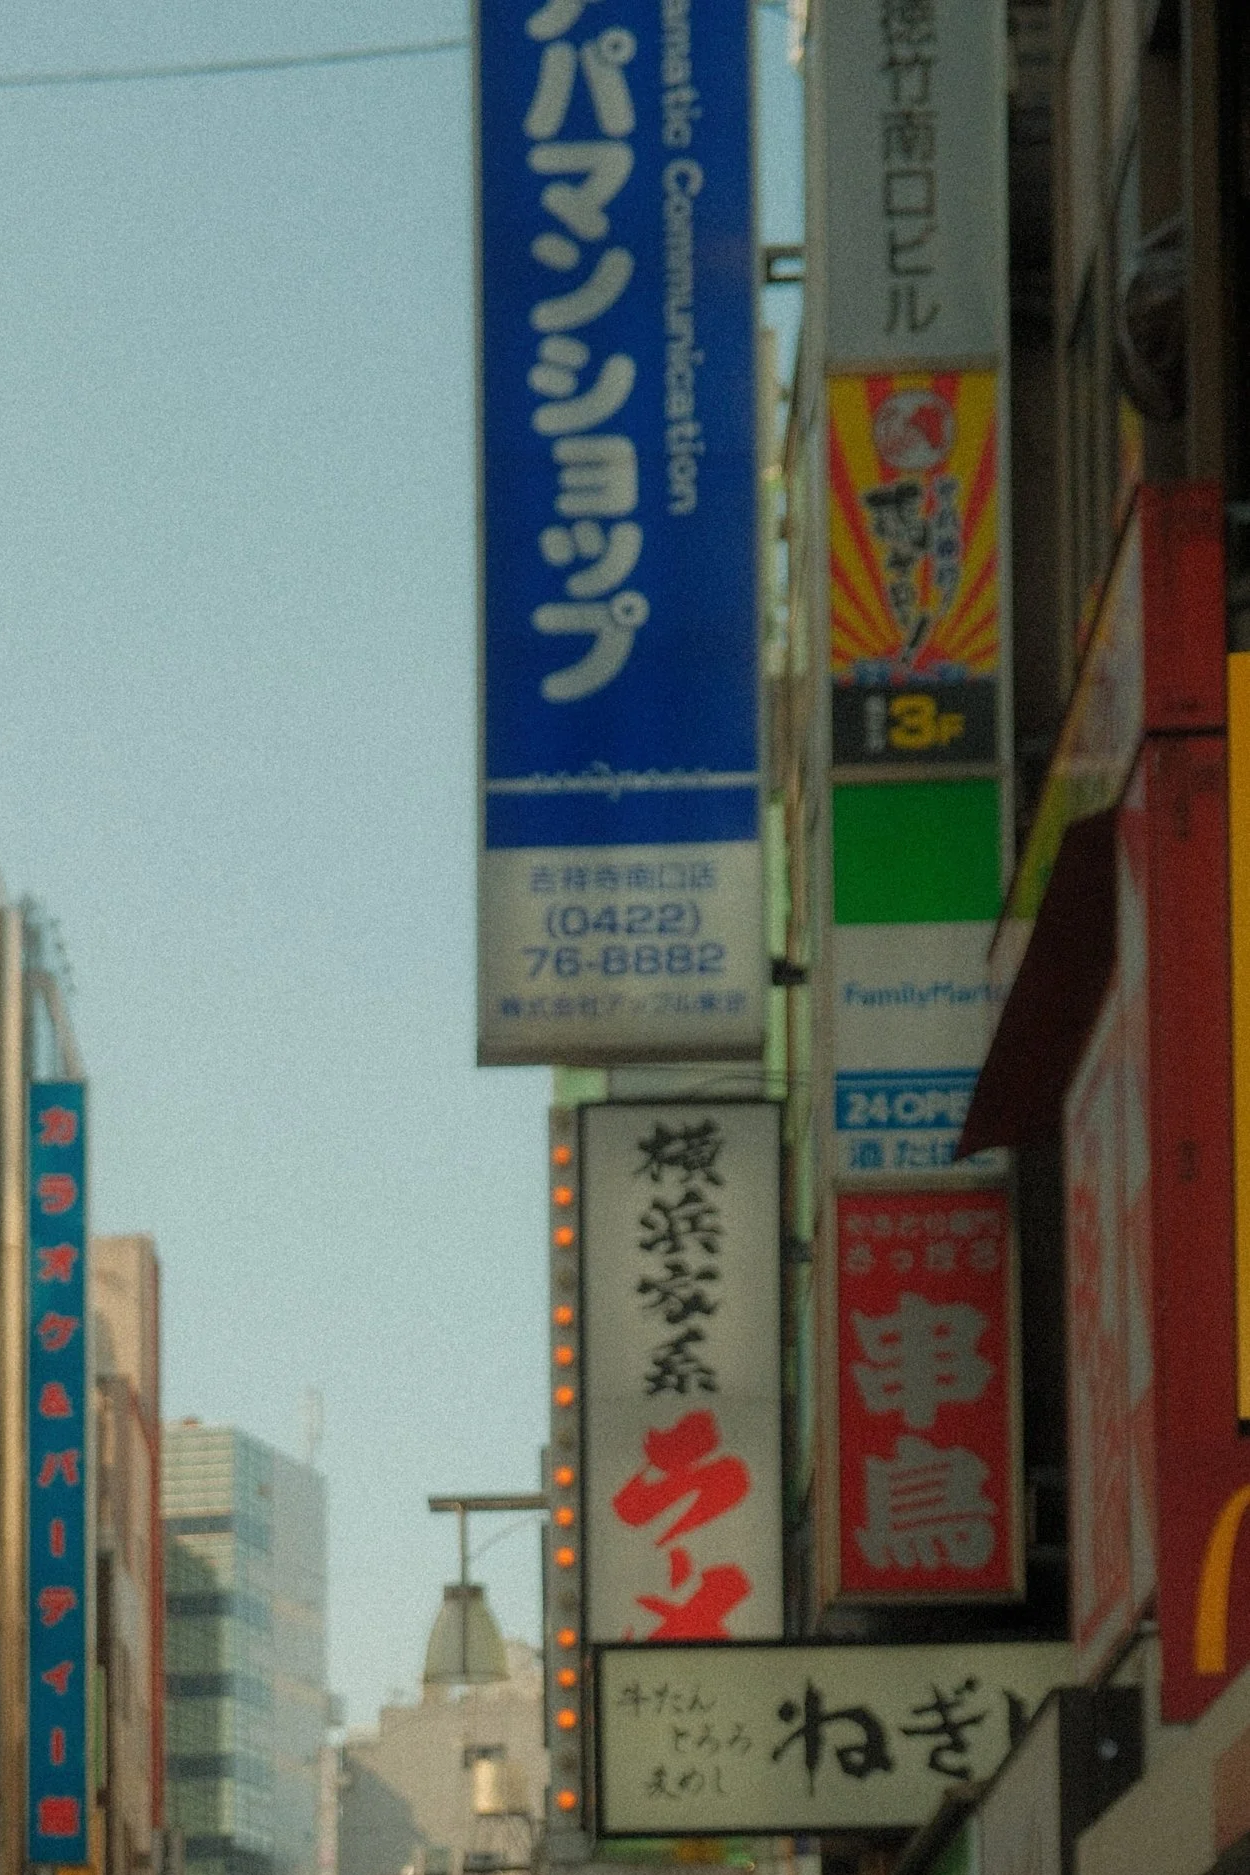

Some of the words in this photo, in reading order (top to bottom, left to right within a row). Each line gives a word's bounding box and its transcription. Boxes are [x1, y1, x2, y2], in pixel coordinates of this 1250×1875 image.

[662, 157, 705, 516] Communication
[522, 944, 725, 979] 76-8882
[545, 902, 702, 938] (0422)
[848, 1291, 998, 1572] 串鳥
